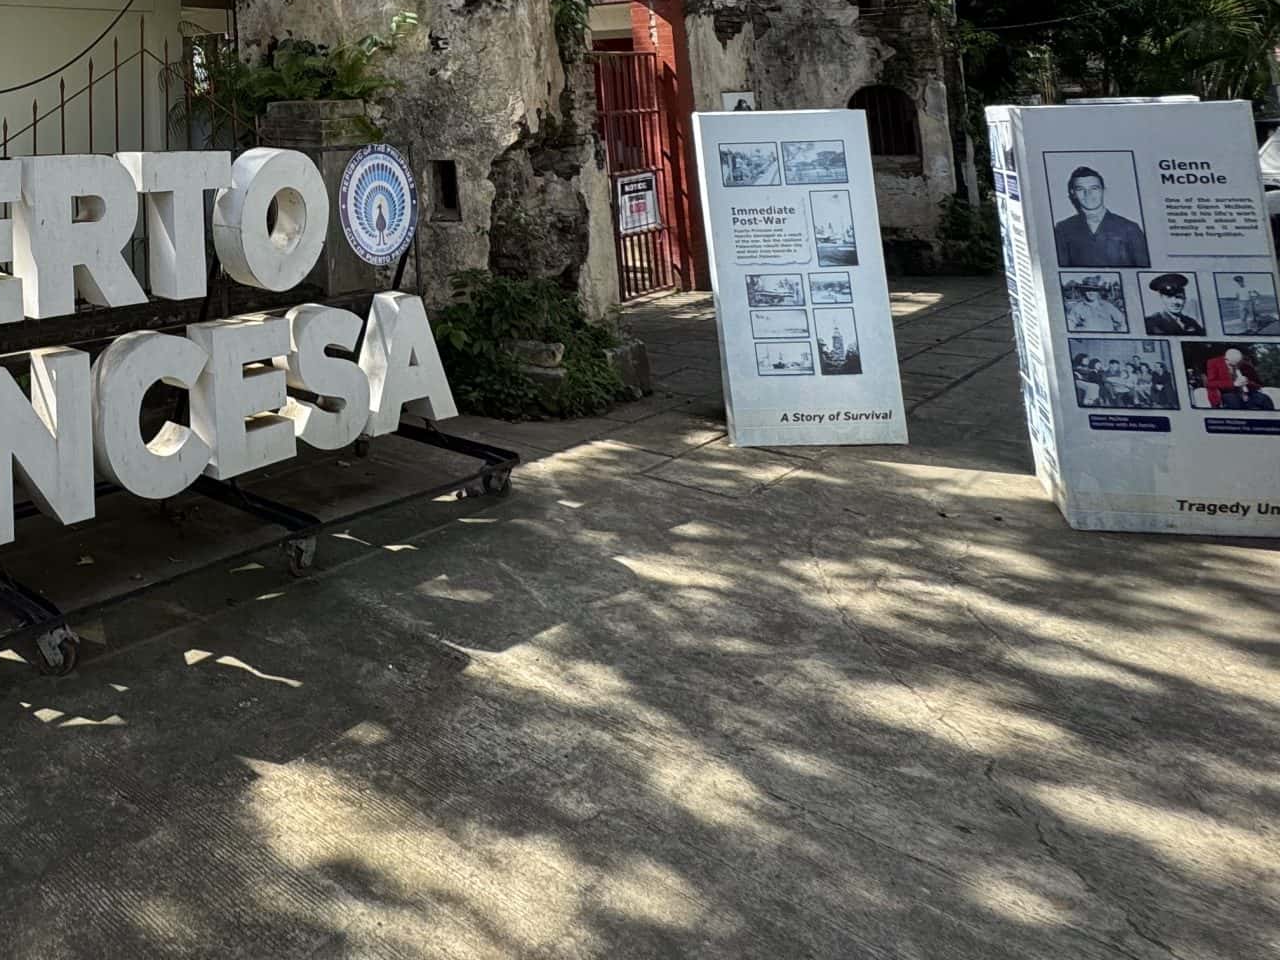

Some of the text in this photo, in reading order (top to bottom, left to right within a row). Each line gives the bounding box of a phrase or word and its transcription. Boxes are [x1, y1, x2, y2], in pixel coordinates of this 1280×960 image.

[1159, 159, 1211, 171] Glenn
[1160, 172, 1228, 185] McDole
[731, 205, 796, 216] Immediate
[732, 216, 787, 226] Post-War
[780, 409, 893, 424] A Story of Survival
[1176, 499, 1280, 517] Tragedy Un
